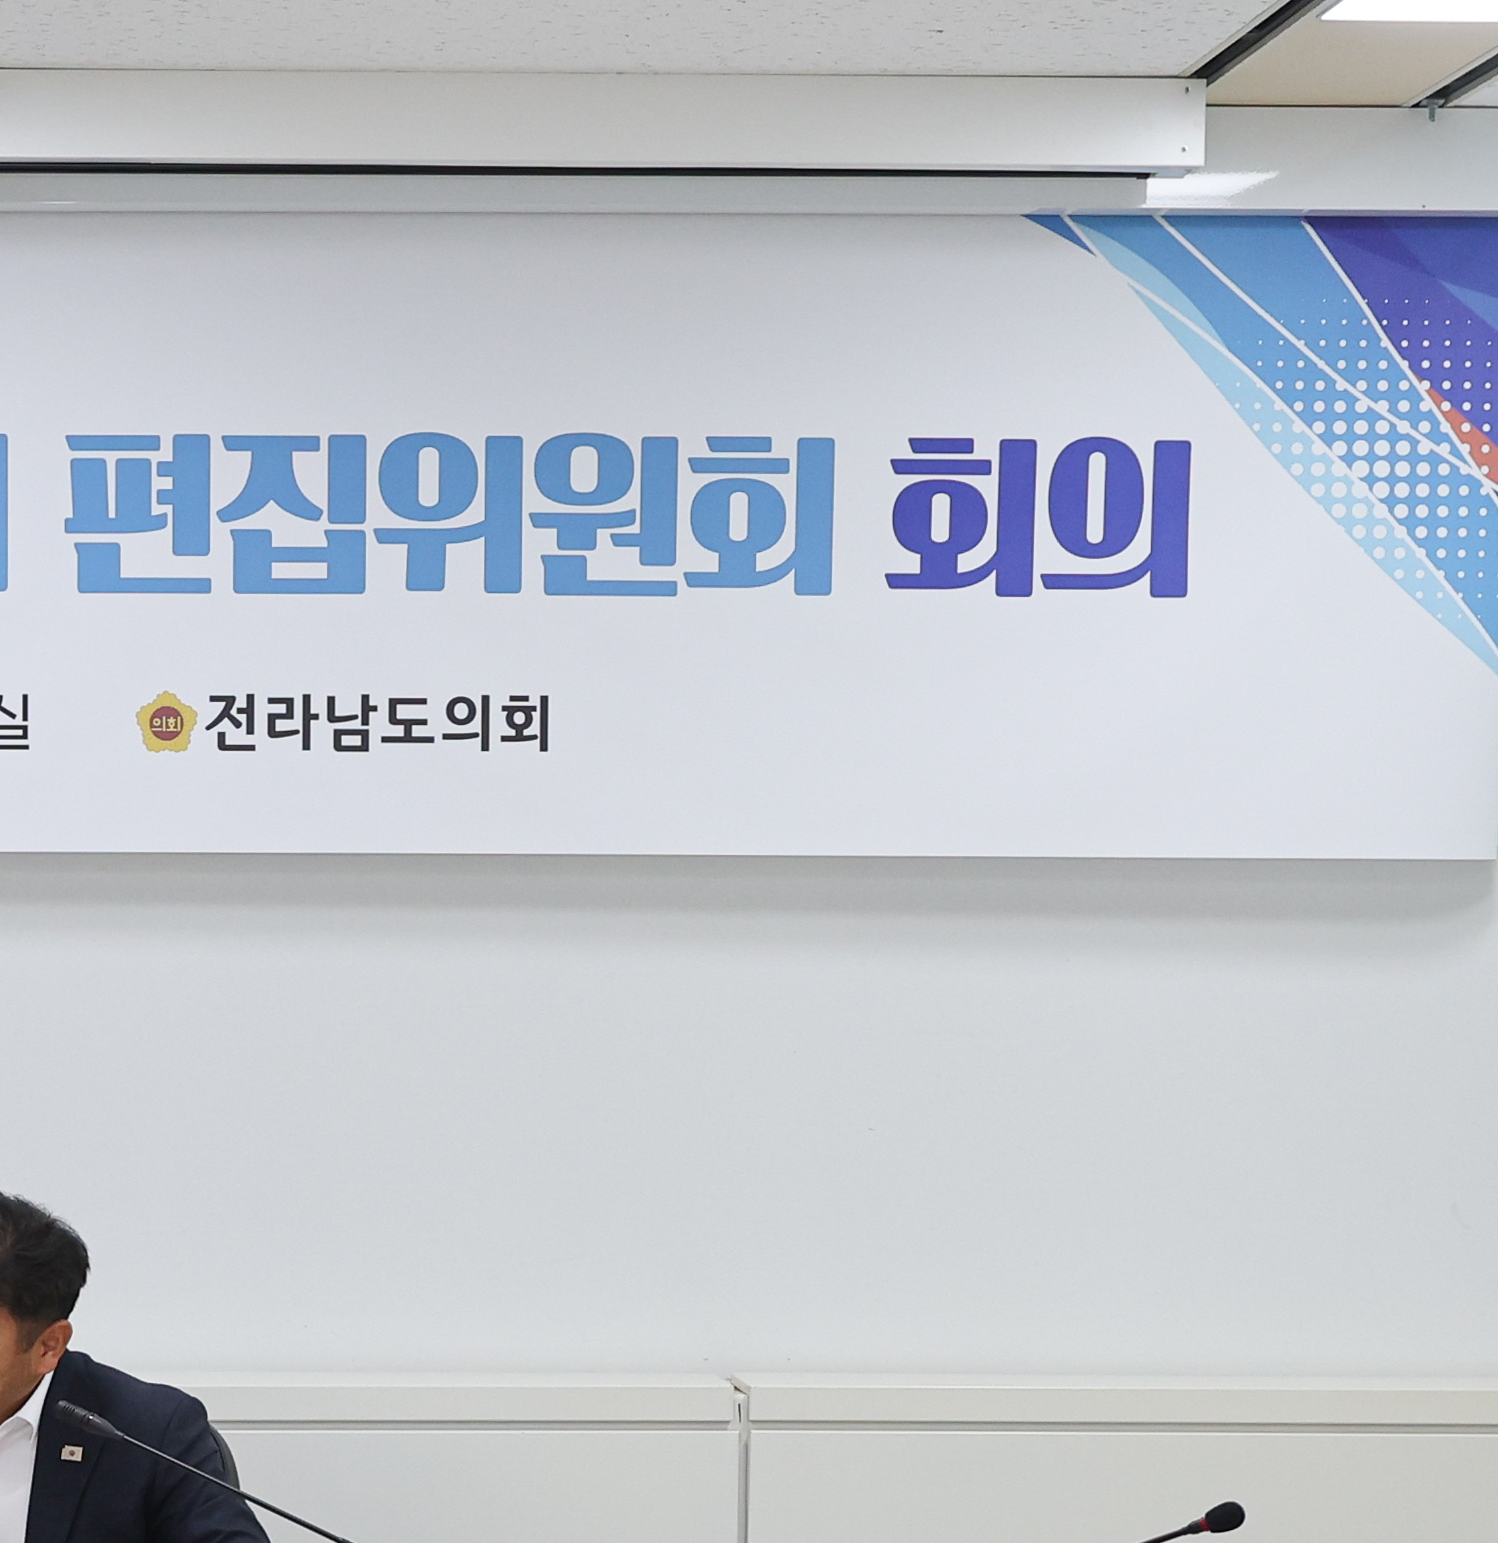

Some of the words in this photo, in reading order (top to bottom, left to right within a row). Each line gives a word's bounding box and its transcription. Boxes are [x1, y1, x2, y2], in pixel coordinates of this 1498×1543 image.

[65, 432, 835, 597] 편집위원회
[885, 436, 1191, 598] 회의
[151, 715, 181, 732] 의회
[205, 693, 549, 752] 전라남도의회
